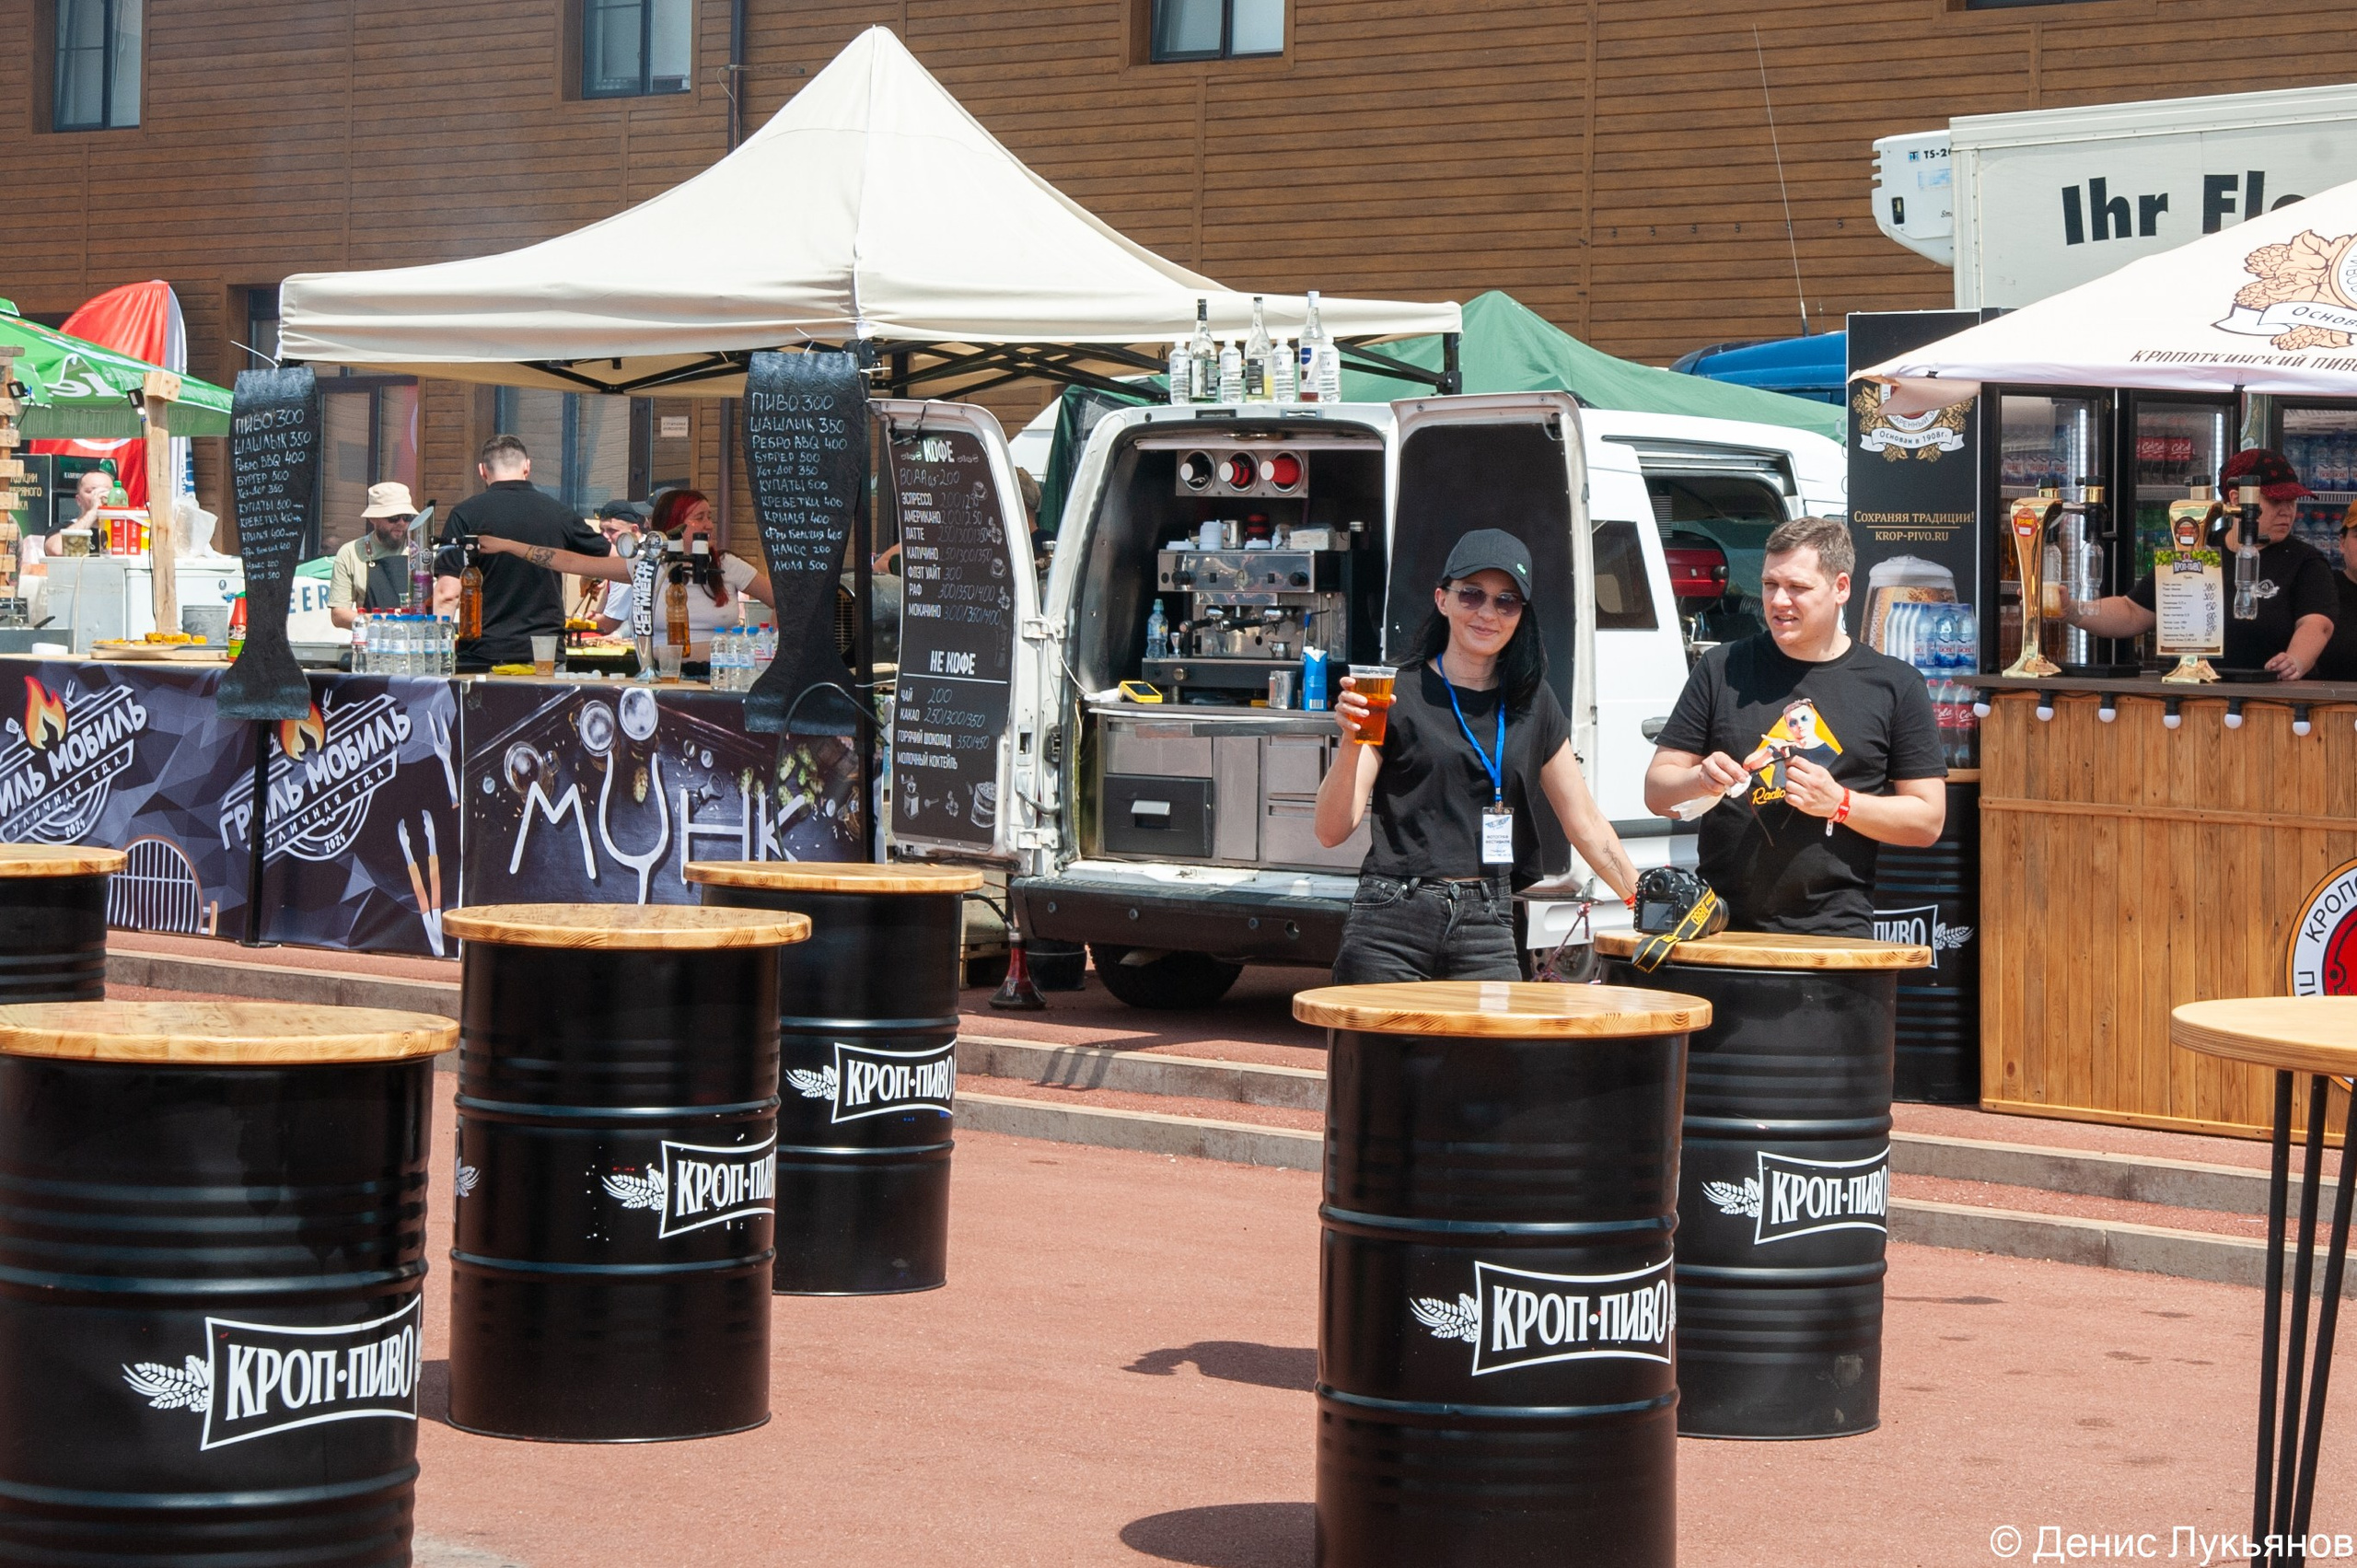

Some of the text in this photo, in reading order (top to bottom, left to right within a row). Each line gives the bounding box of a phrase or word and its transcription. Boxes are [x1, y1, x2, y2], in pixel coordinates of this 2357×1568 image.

[2061, 176, 2168, 246] Ihr
[2130, 350, 2306, 367] КРОПОТКИНСКИЙ
[752, 392, 834, 413] ПИВО 300
[236, 409, 304, 434] ПИВО 300
[750, 416, 845, 434] ШАШЛЫК 350
[234, 431, 311, 455] ШАШЛЫК 350
[752, 435, 791, 449] РЕБРО
[825, 437, 847, 449] 400
[284, 450, 306, 464] 400
[799, 452, 820, 463] 500
[923, 440, 955, 462] КОФЕ
[798, 465, 819, 476] 350
[760, 479, 805, 493] КУПАТЫ
[238, 500, 273, 514] КУПАТЫ
[824, 495, 843, 507] 400
[901, 492, 933, 505] ЭСПРЕССО
[764, 510, 830, 524] КРЫЛЬЯ 400
[904, 510, 941, 524] АМЕРИКАНО
[905, 527, 924, 540] ЛАТТЕ
[1875, 531, 1949, 541] KROP-PIVO.RU
[906, 546, 938, 561] КАПУЧИНО
[809, 560, 828, 571] 500
[908, 563, 962, 580] ФЛЭТ УАЙТ 300
[633, 559, 649, 634] ПРЕМИУМ
[909, 583, 923, 596] РАФ
[641, 561, 656, 636] СЕГМЕНТ
[908, 603, 941, 618] МОКАЧИНО
[930, 650, 976, 675] НЕ КОФЕ
[900, 687, 952, 703] ЧАЙ 200
[900, 708, 920, 722] КАКАО
[47, 697, 147, 782] МОБИЛЬ
[898, 729, 923, 744] ГОРЯЧИЙ
[923, 733, 952, 749] ШОКОЛАД
[897, 751, 958, 770] МОЛОЧНЫЙ КОКТЕЙЛЬ
[219, 707, 412, 851] ГРЛЬ МОБИЛЬ
[13, 756, 121, 834] УЛИЧНАЯ ЕДА
[1752, 786, 1786, 805] Radio
[266, 767, 384, 849] УЛИЧНАЯ ЕДА
[64, 819, 86, 839] 2024
[324, 832, 346, 853] 2024
[2305, 875, 2357, 944] КРОП
[676, 1153, 775, 1217] КРОП·ПИВ
